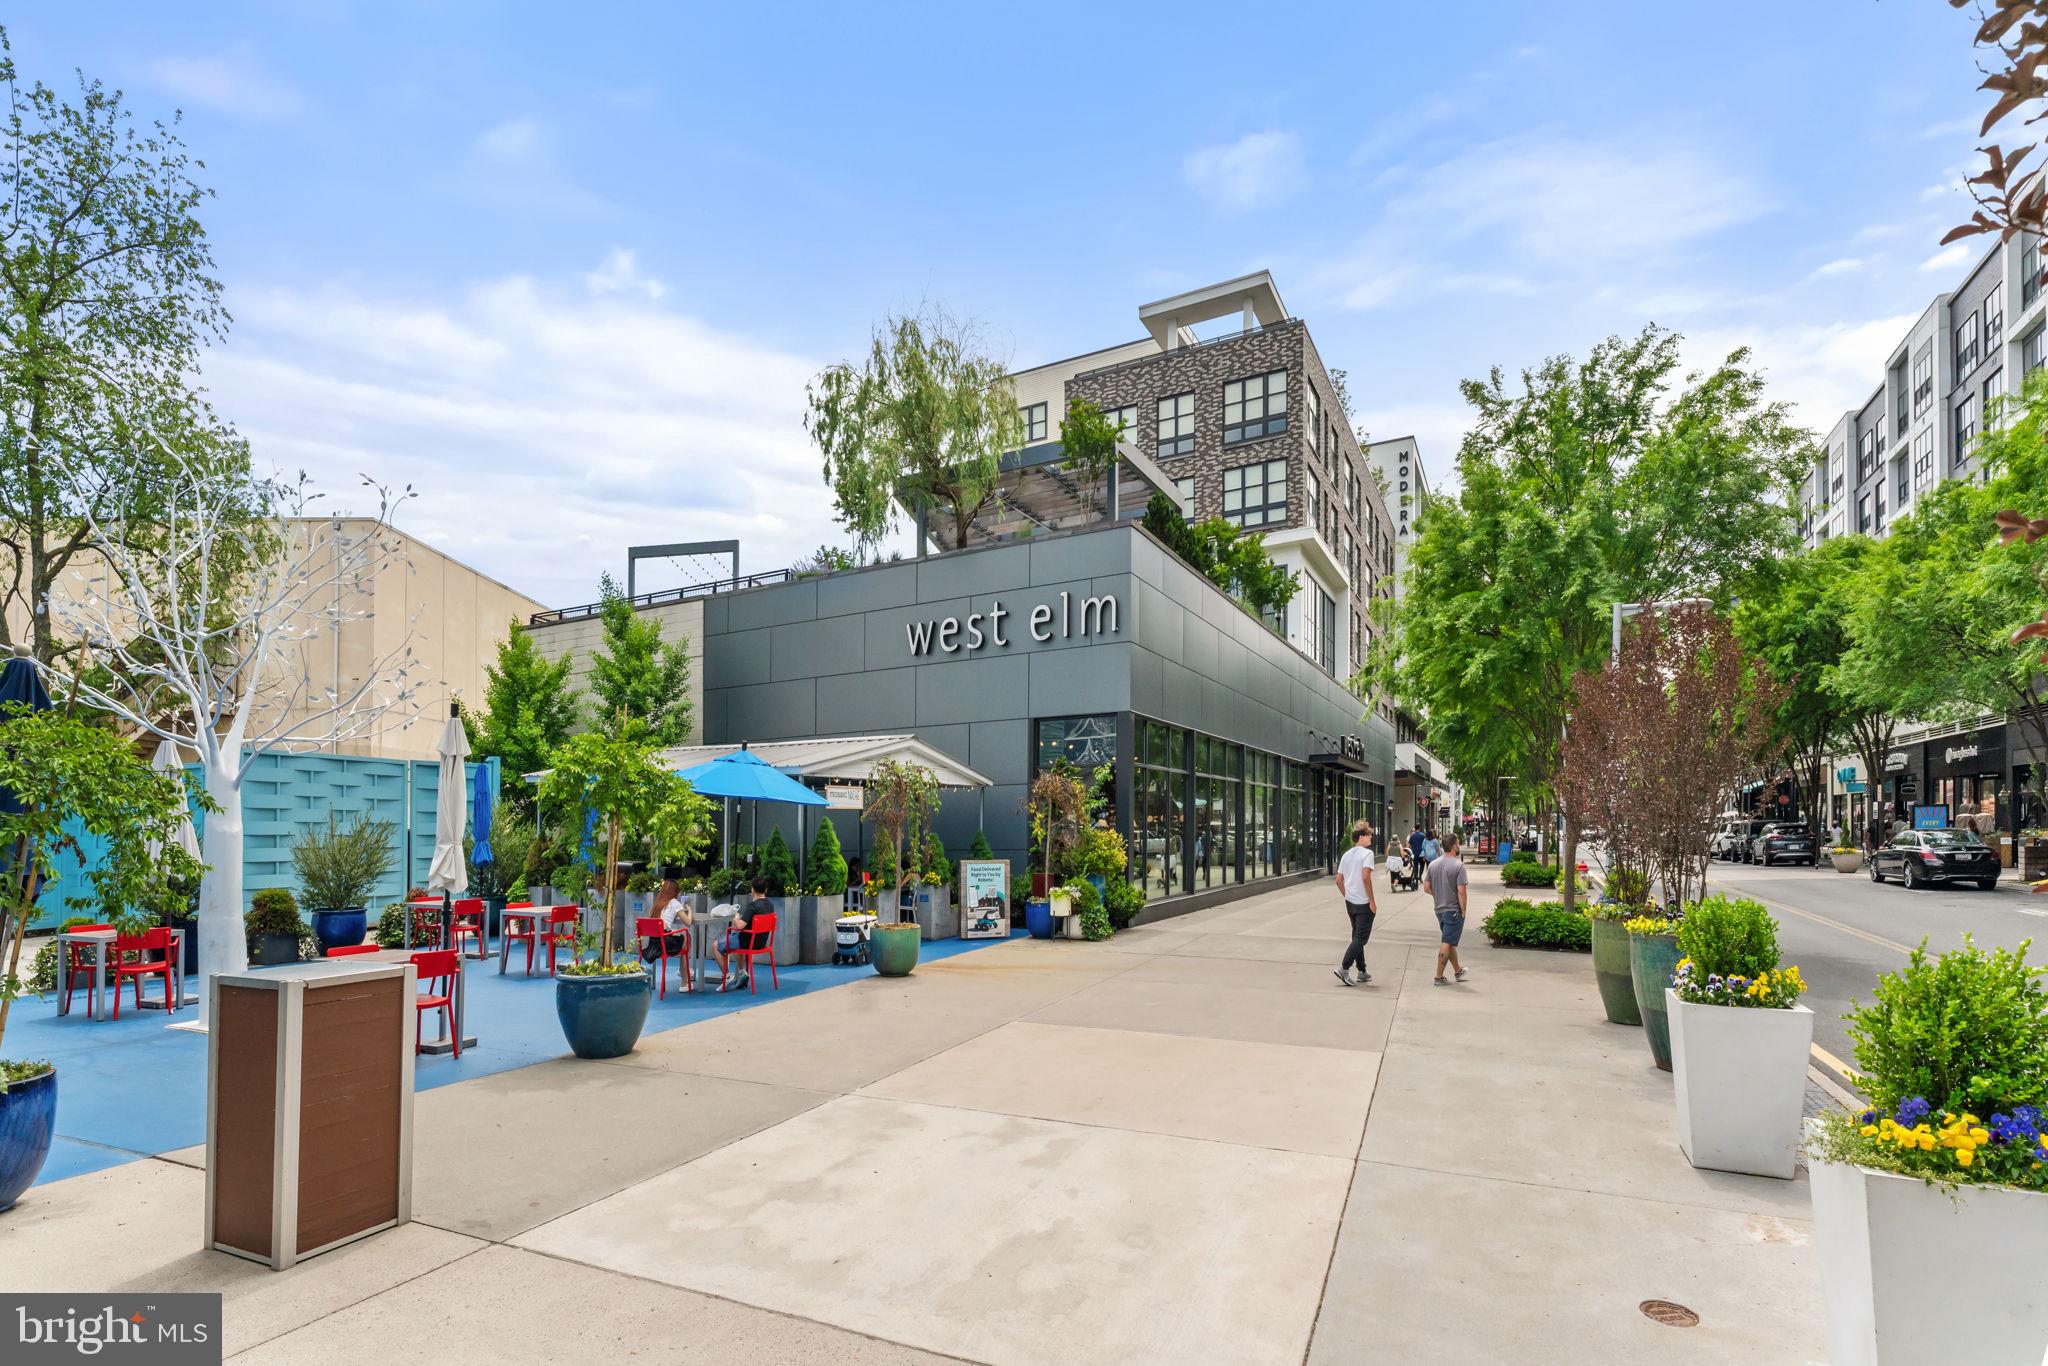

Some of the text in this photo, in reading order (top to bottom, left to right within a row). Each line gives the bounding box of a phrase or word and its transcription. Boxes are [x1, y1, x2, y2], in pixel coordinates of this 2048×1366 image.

[1399, 450, 1409, 536] MODERA
[906, 591, 1118, 656] west elm
